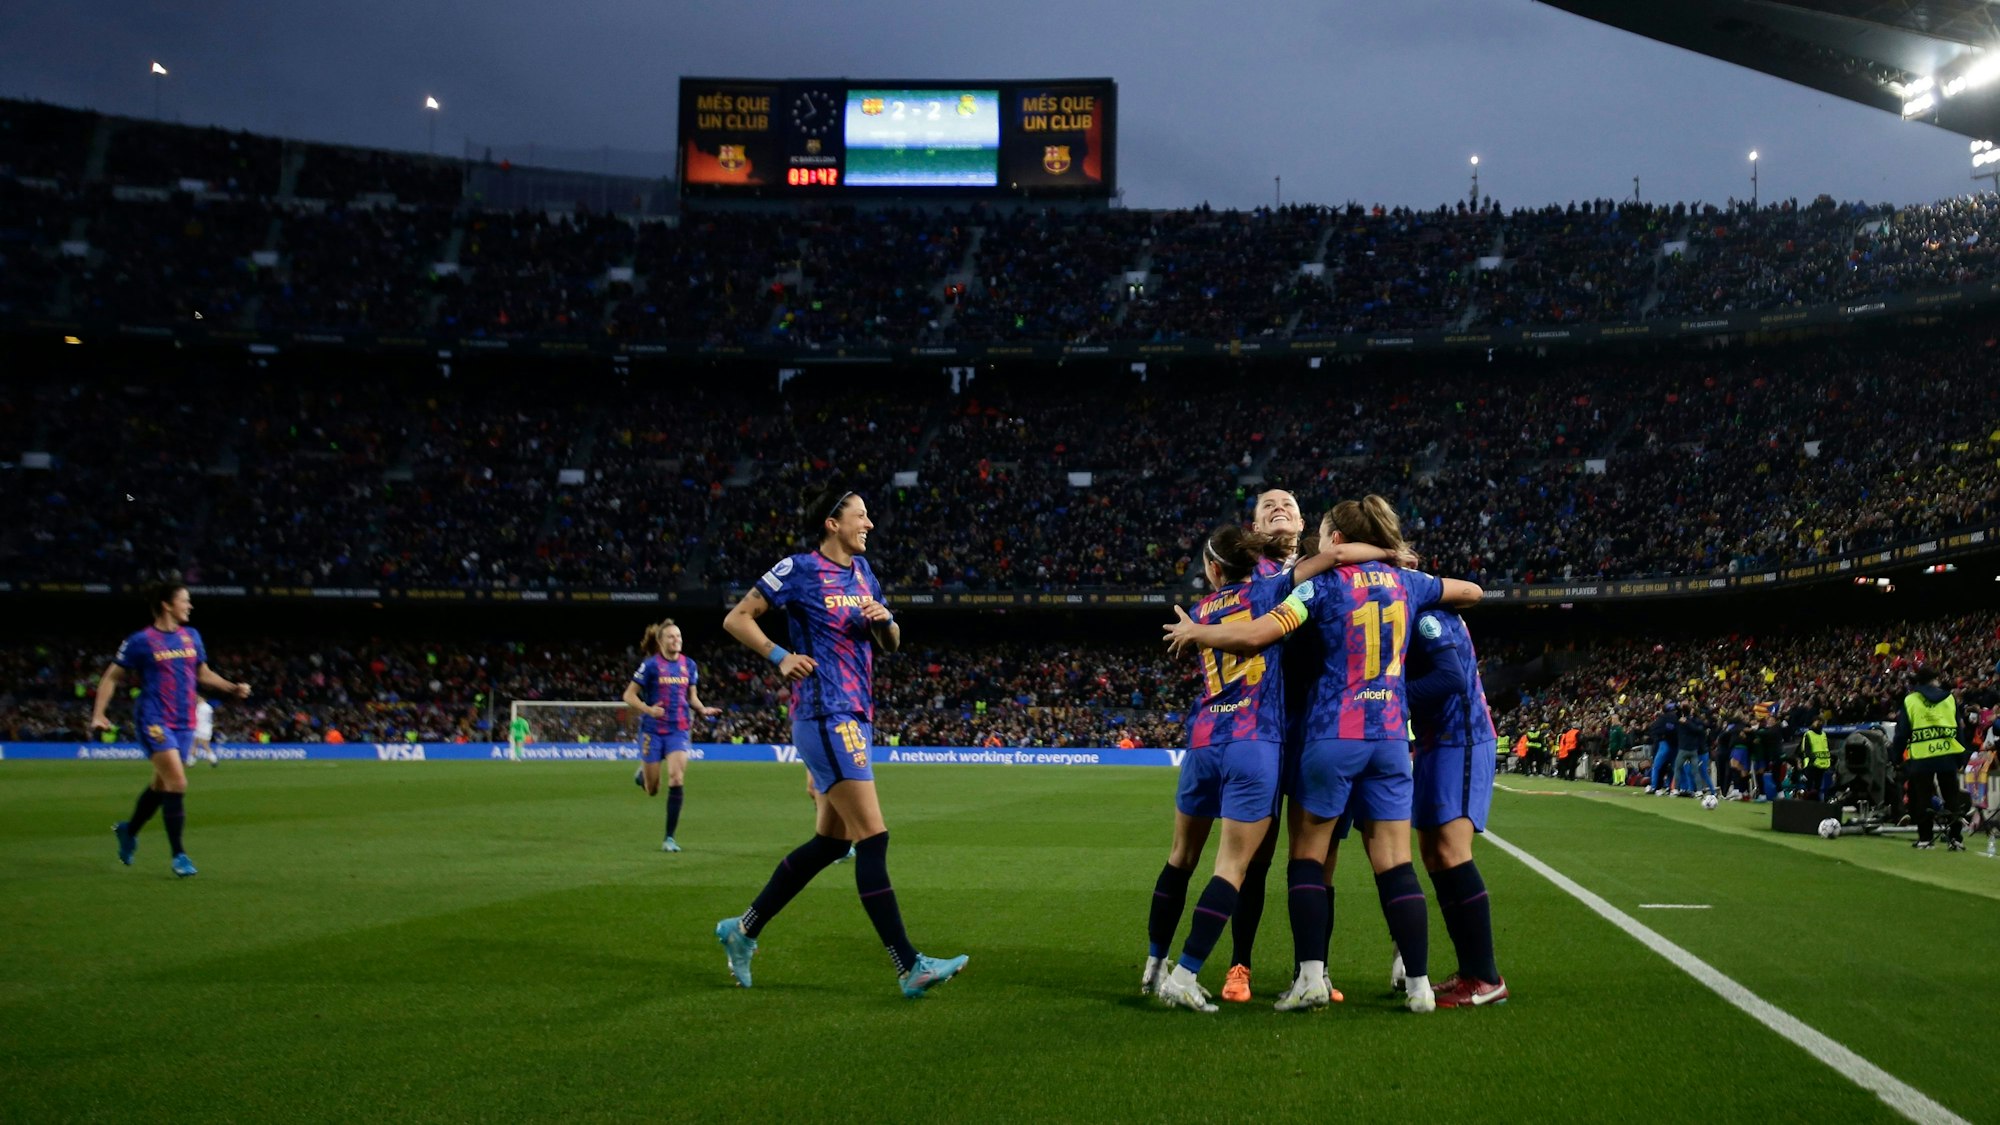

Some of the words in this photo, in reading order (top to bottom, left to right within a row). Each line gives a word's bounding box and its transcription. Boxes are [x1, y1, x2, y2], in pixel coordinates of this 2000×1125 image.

[698, 92, 733, 110] MÉS
[737, 96, 770, 112] QUE
[1023, 93, 1058, 111] MÉS
[1061, 96, 1094, 113] QUE
[892, 101, 905, 120] 2
[927, 101, 941, 120] 2
[699, 114, 721, 128] UN
[726, 114, 769, 129] CLUB
[1024, 115, 1048, 130] UN
[1051, 114, 1093, 129] CLUB
[1528, 589, 1546, 597] MORE
[1547, 588, 1565, 596] THAN
[1571, 587, 1598, 595] PLAYERS
[1620, 584, 1632, 593] MÉS
[1632, 584, 1645, 594] QUE
[1645, 583, 1654, 592] UN
[1654, 583, 1669, 591] CLUB
[1352, 600, 1406, 680] 11
[1353, 688, 1386, 700] unicef
[375, 744, 426, 760] VISA
[491, 746, 503, 758] A
[562, 746, 617, 761] working
[619, 746, 640, 759] for
[1928, 741, 1951, 753] 640
[890, 750, 900, 761] A
[901, 750, 958, 762] network
[959, 751, 1014, 764] working
[1014, 752, 1036, 763] for
[1036, 754, 1100, 764] everyone
